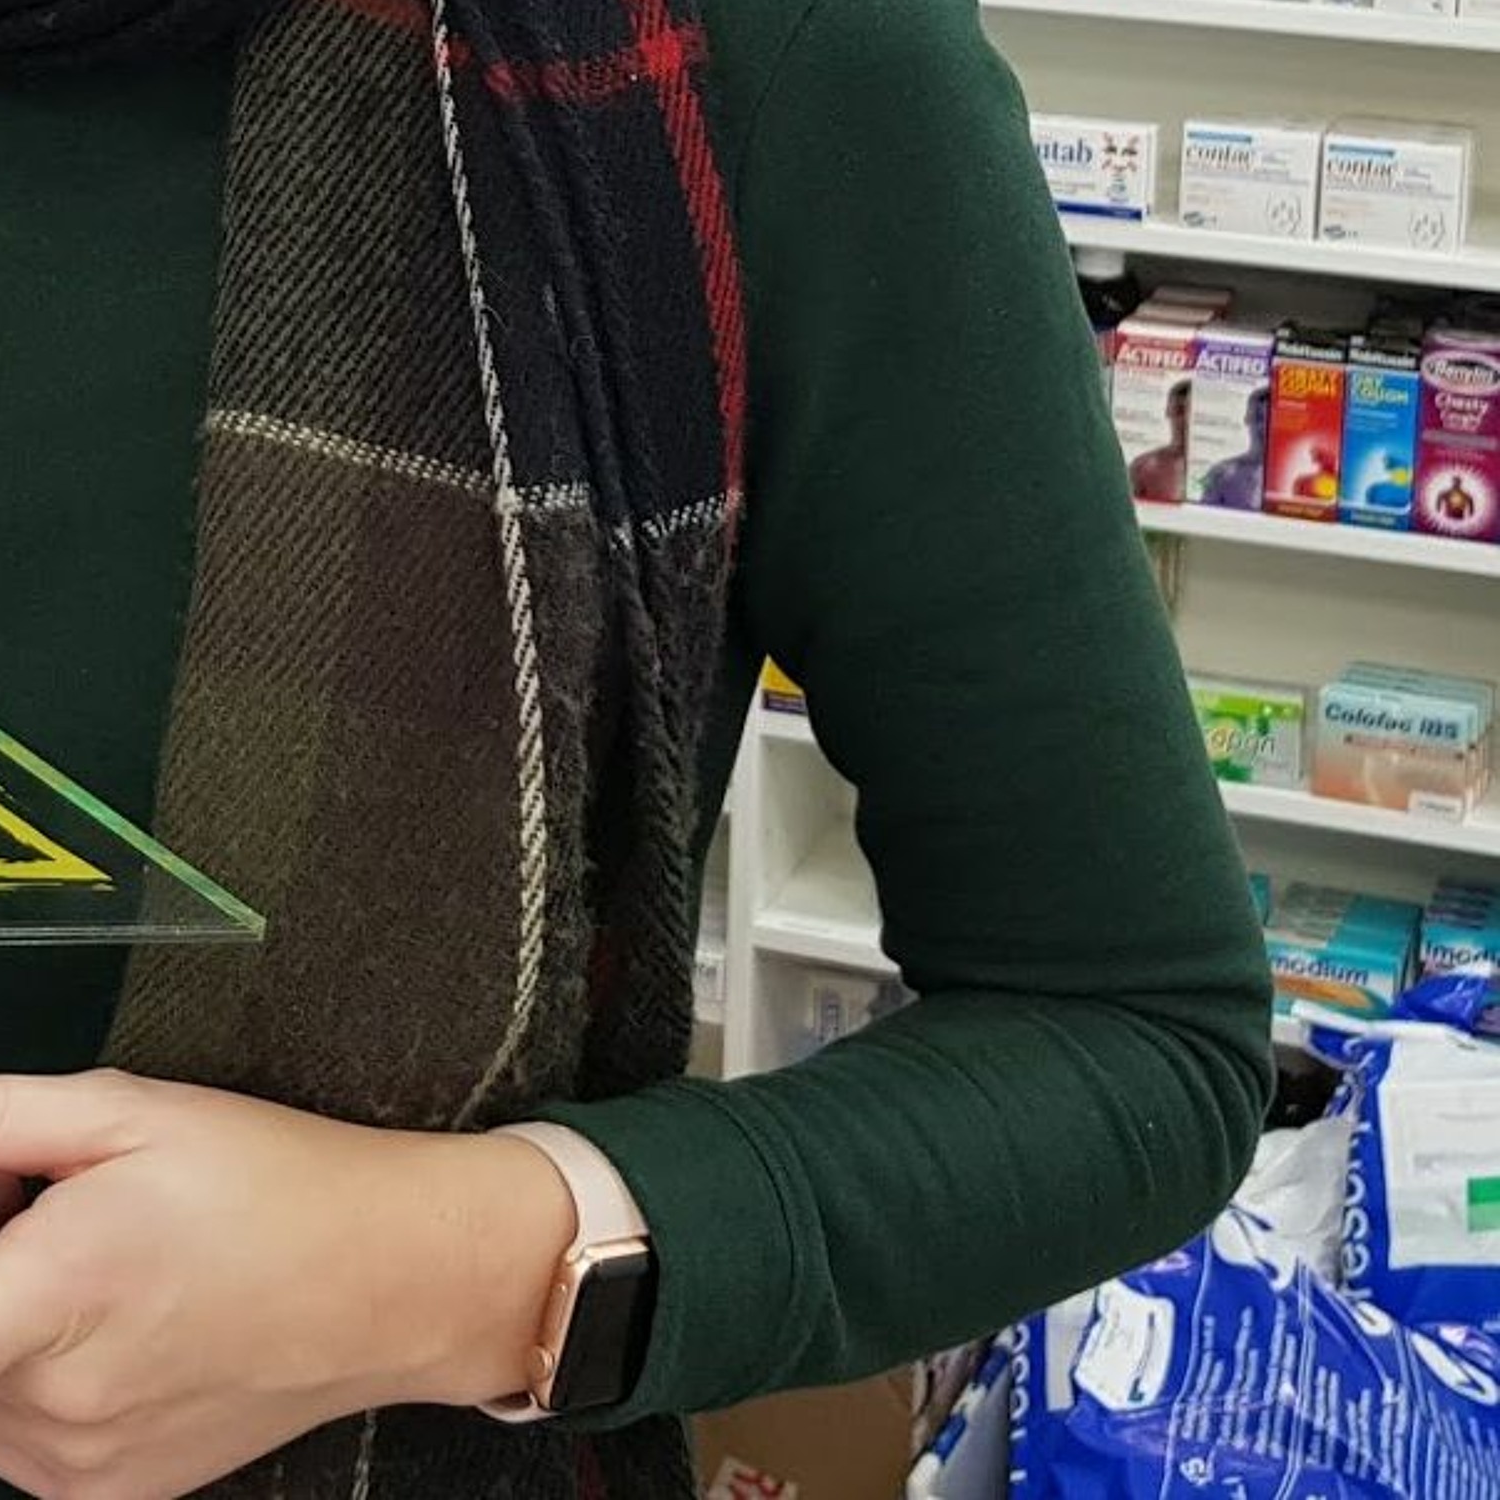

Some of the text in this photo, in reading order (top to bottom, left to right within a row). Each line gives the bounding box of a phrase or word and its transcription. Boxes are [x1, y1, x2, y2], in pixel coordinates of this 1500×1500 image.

[1036, 136, 1093, 164] utab
[1434, 358, 1495, 386] Benylin
[1324, 702, 1460, 740] Colofac IBS
[1425, 940, 1500, 967] Imodi
[1275, 954, 1369, 986] modium
